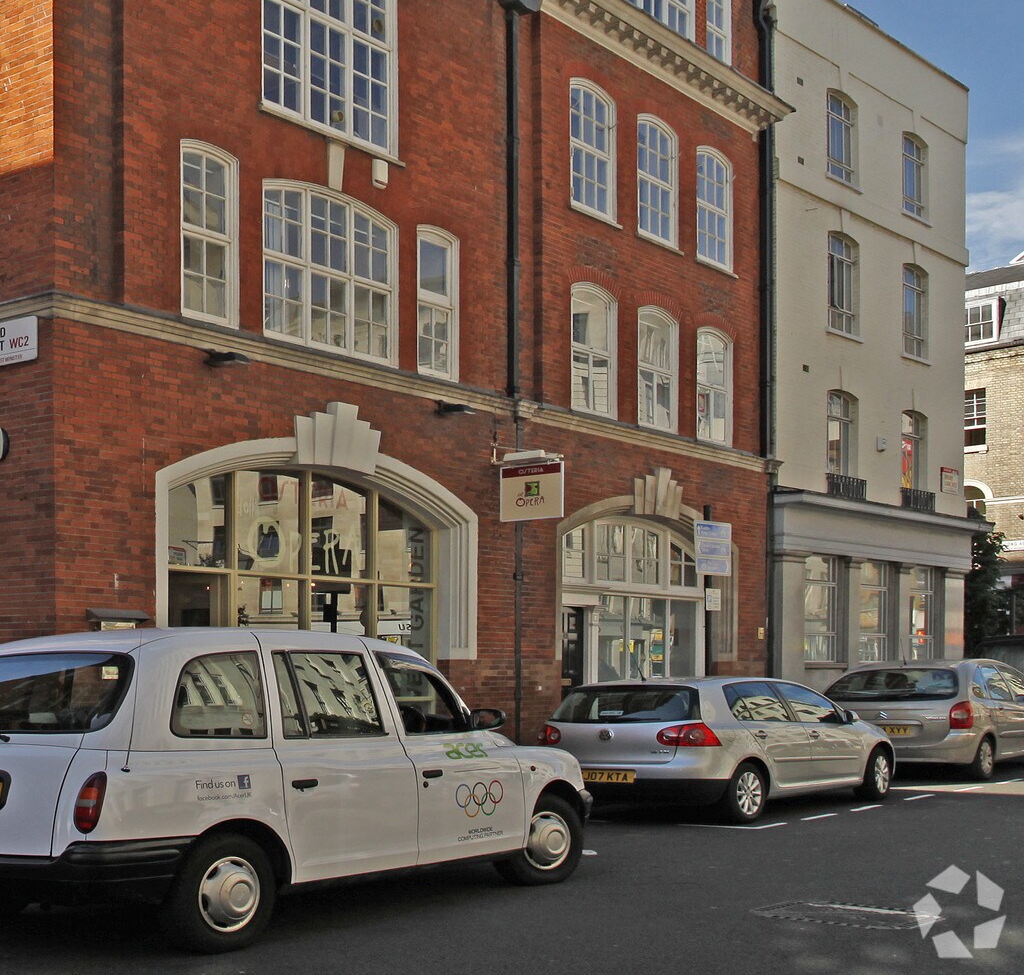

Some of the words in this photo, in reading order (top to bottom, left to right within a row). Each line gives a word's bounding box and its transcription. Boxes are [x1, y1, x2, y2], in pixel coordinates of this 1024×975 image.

[9, 336, 29, 349] WC2
[518, 467, 544, 475] OSTERIA
[516, 496, 545, 507] OPERA
[443, 742, 488, 760] acer
[581, 771, 604, 781] J07
[607, 772, 628, 782] KTA
[195, 779, 214, 789] Find
[225, 780, 236, 788] on
[468, 826, 493, 834] WORLDWIDE
[457, 833, 484, 842] COMPUTING
[484, 830, 504, 839] PARTNER
